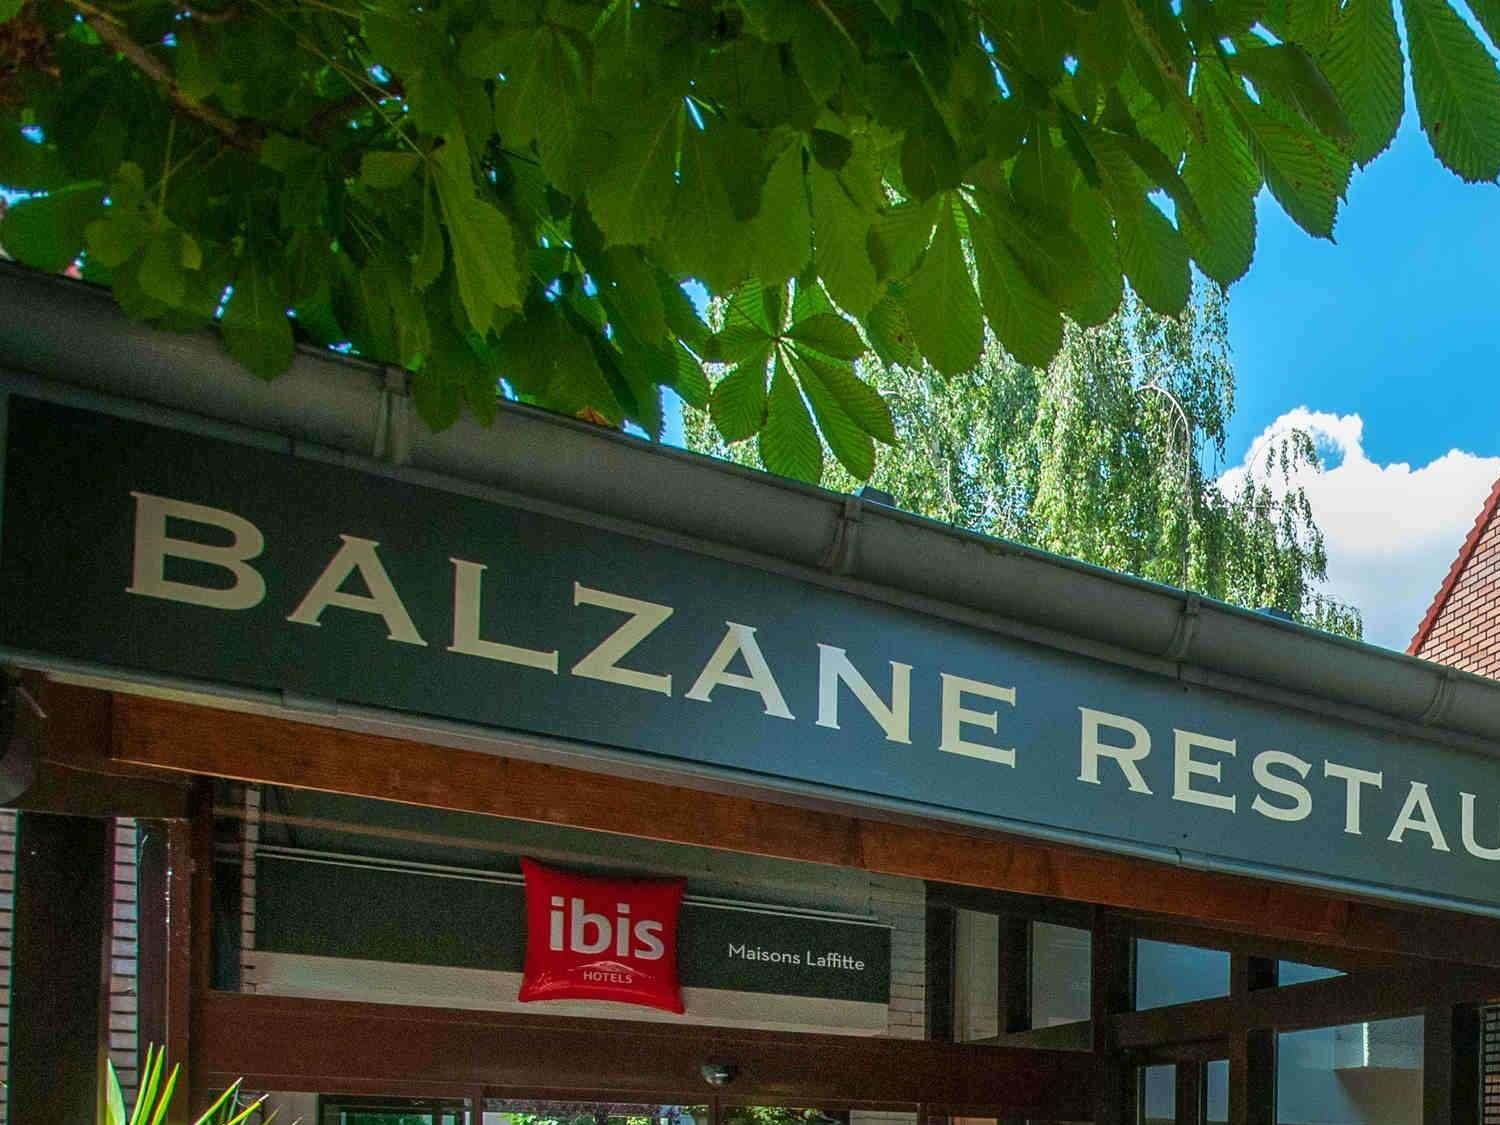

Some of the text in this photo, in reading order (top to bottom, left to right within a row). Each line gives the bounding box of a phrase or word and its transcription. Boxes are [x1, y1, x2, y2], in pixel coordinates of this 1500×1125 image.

[125, 490, 1016, 768] BALZANE
[550, 896, 665, 961] ibis
[583, 971, 632, 985] HOTELS
[728, 943, 865, 971] Maisons Laffitte
